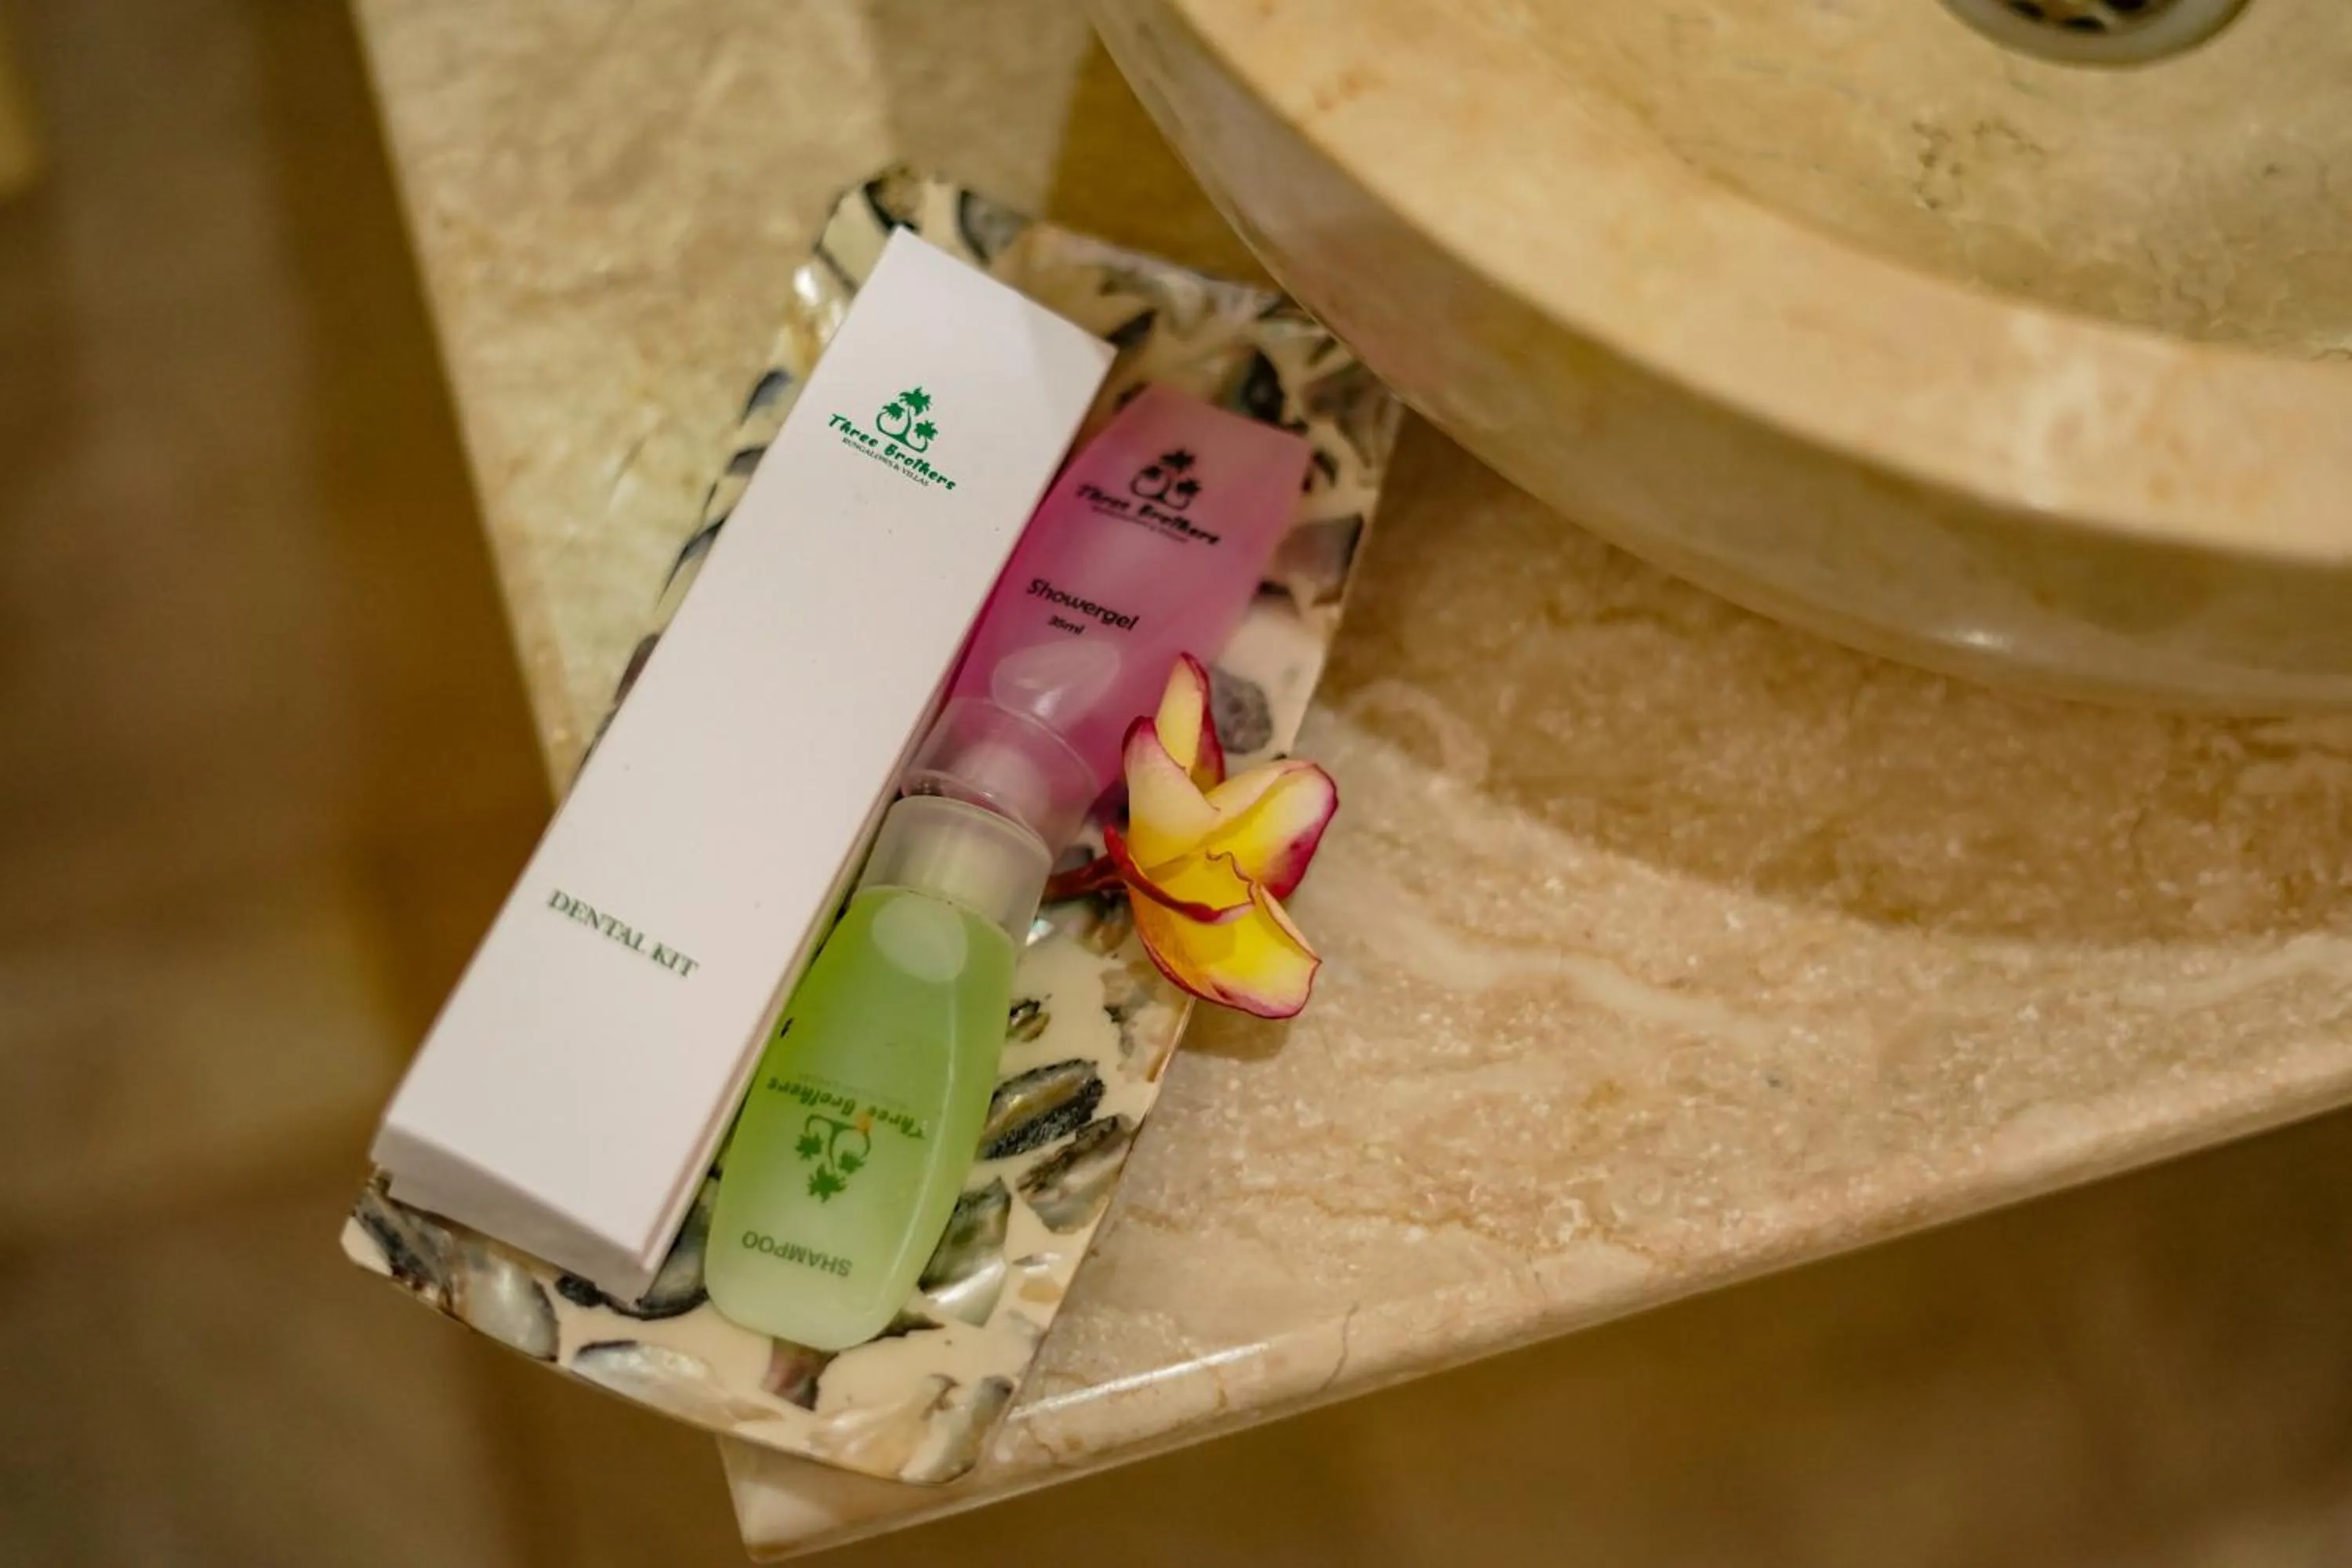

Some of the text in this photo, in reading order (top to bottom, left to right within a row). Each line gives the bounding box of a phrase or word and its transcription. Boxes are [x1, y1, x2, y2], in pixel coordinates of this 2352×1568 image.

[829, 413, 956, 490] Three Brothers
[1026, 577, 1141, 632] Showergel
[547, 887, 700, 978] DENTAL KIT
[766, 1076, 857, 1116] Brothers
[866, 1104, 927, 1140] Three
[741, 1229, 854, 1279] SHAMPOO
